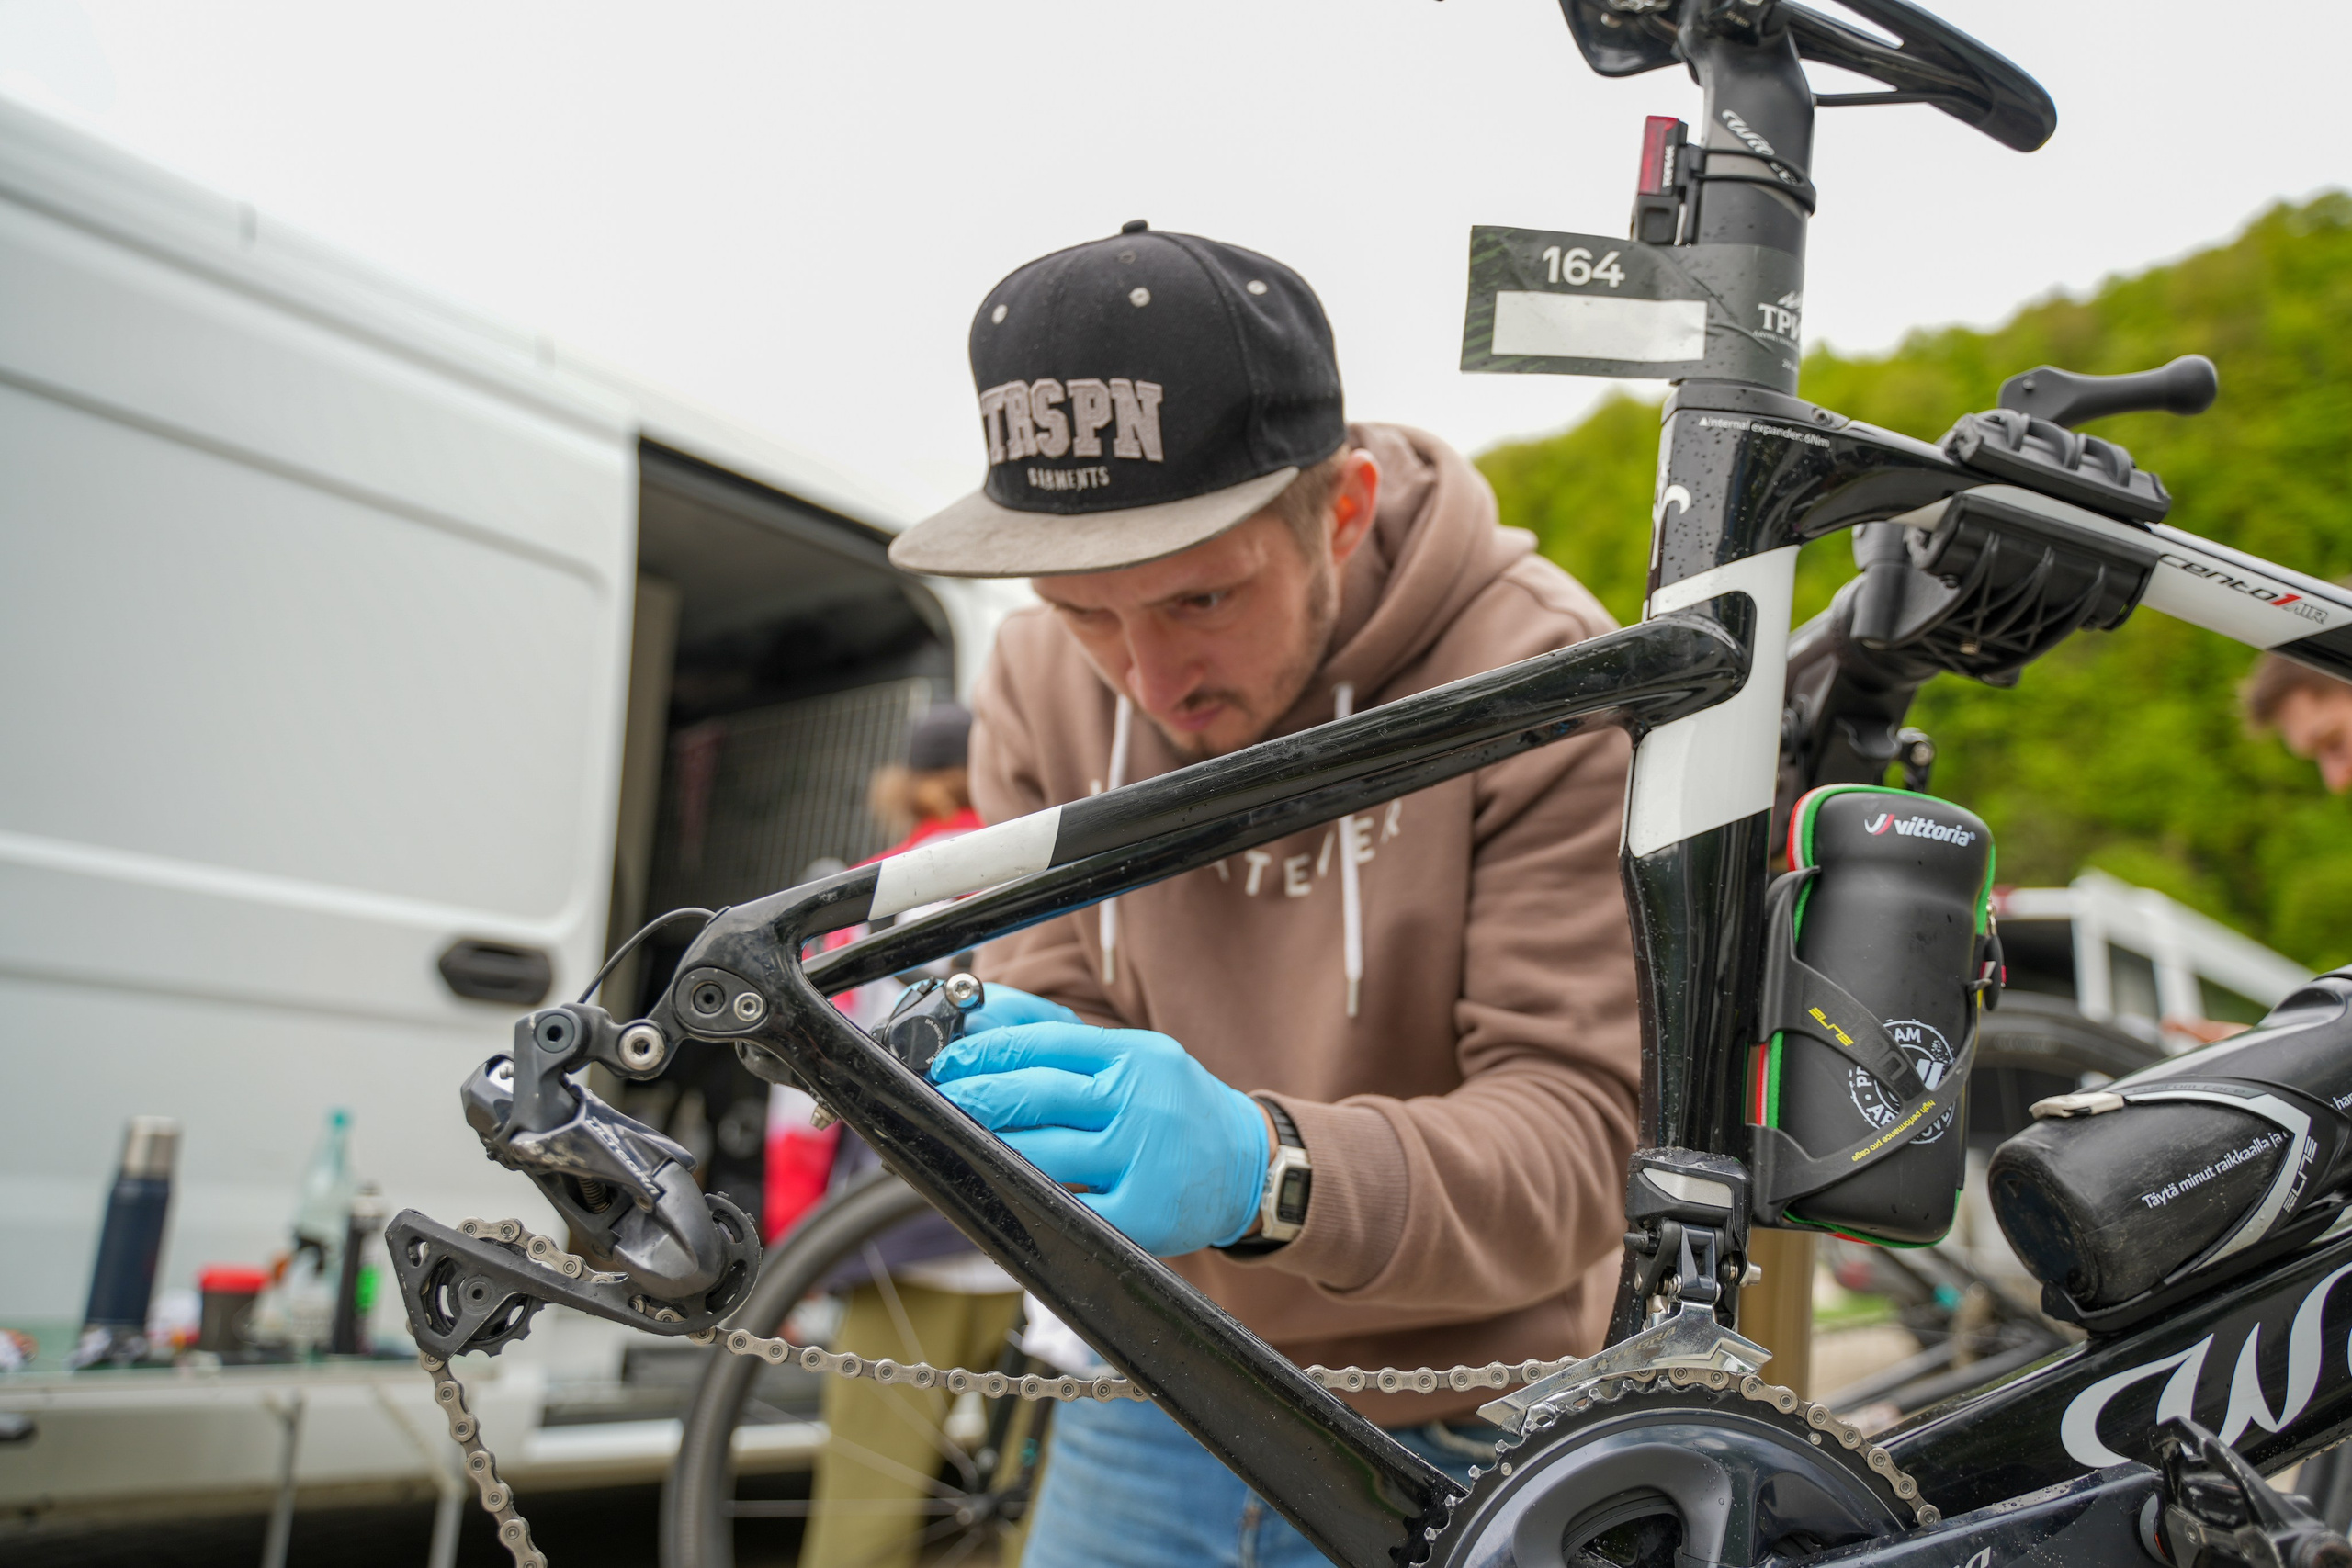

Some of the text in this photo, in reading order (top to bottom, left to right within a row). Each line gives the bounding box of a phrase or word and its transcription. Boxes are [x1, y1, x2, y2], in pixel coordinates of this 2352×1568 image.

[1543, 245, 1626, 288] 164
[1708, 416, 1751, 431] internal
[1804, 433, 1830, 448] 6Nm
[1027, 466, 1111, 491] GARMENTS
[586, 1119, 660, 1194] ULTEGRA
[1851, 1100, 1936, 1161] high performance pro cage
[2142, 1182, 2180, 1209] Täytä
[2178, 1165, 2217, 1192] minut
[2214, 1137, 2270, 1174] raikkaalla
[2267, 1132, 2283, 1148] ja
